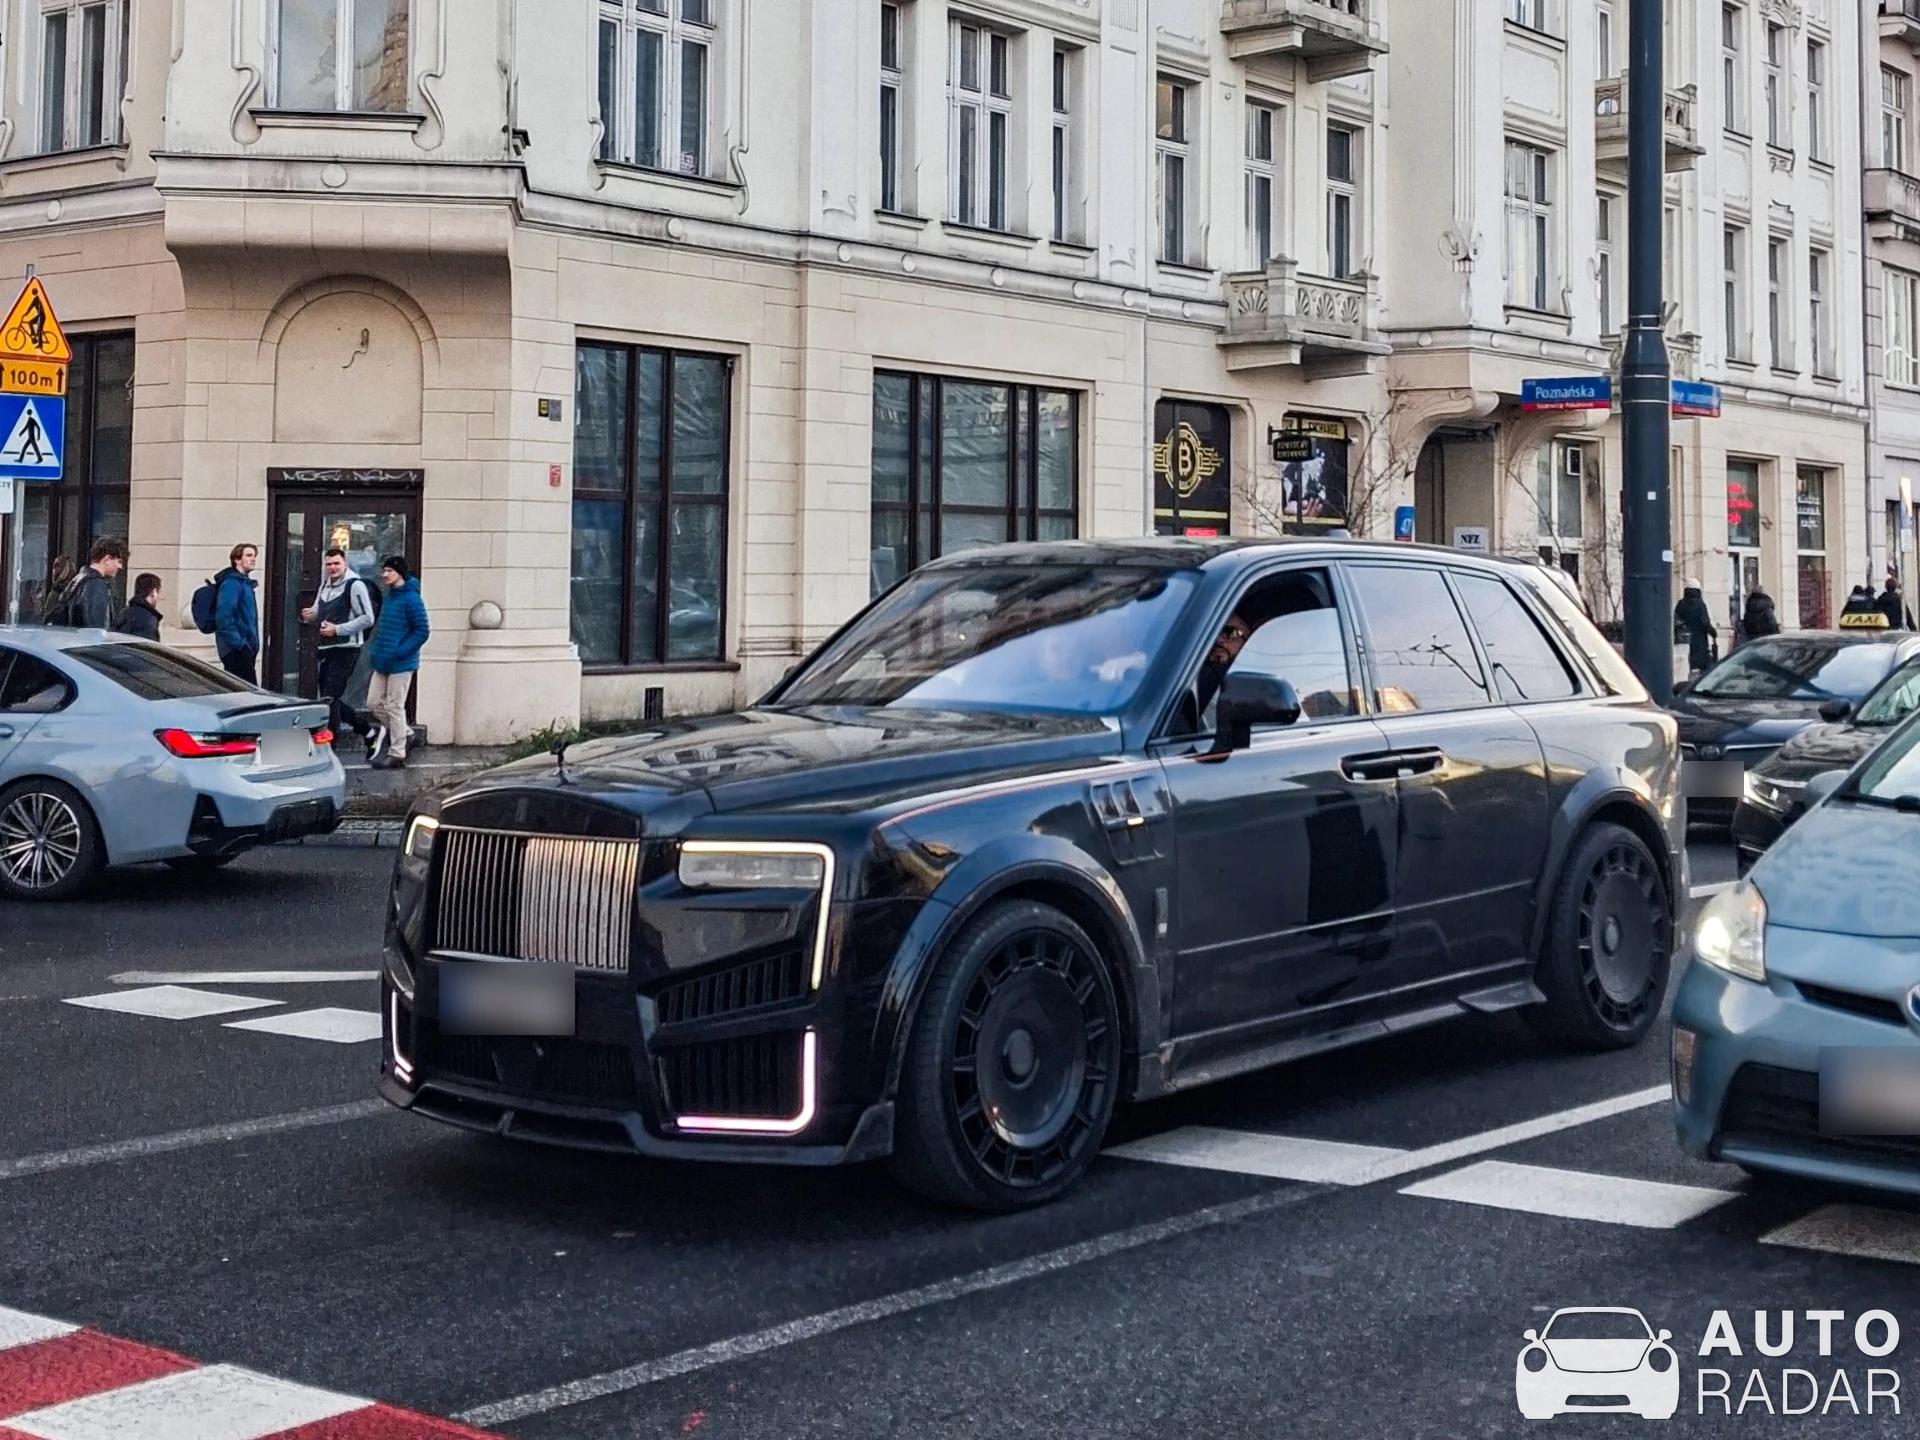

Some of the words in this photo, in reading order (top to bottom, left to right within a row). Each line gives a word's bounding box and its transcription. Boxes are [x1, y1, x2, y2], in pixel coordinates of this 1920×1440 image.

[10, 369, 53, 387] 100m
[1535, 385, 1595, 399] Poznańska
[1846, 615, 1880, 624] TAXI
